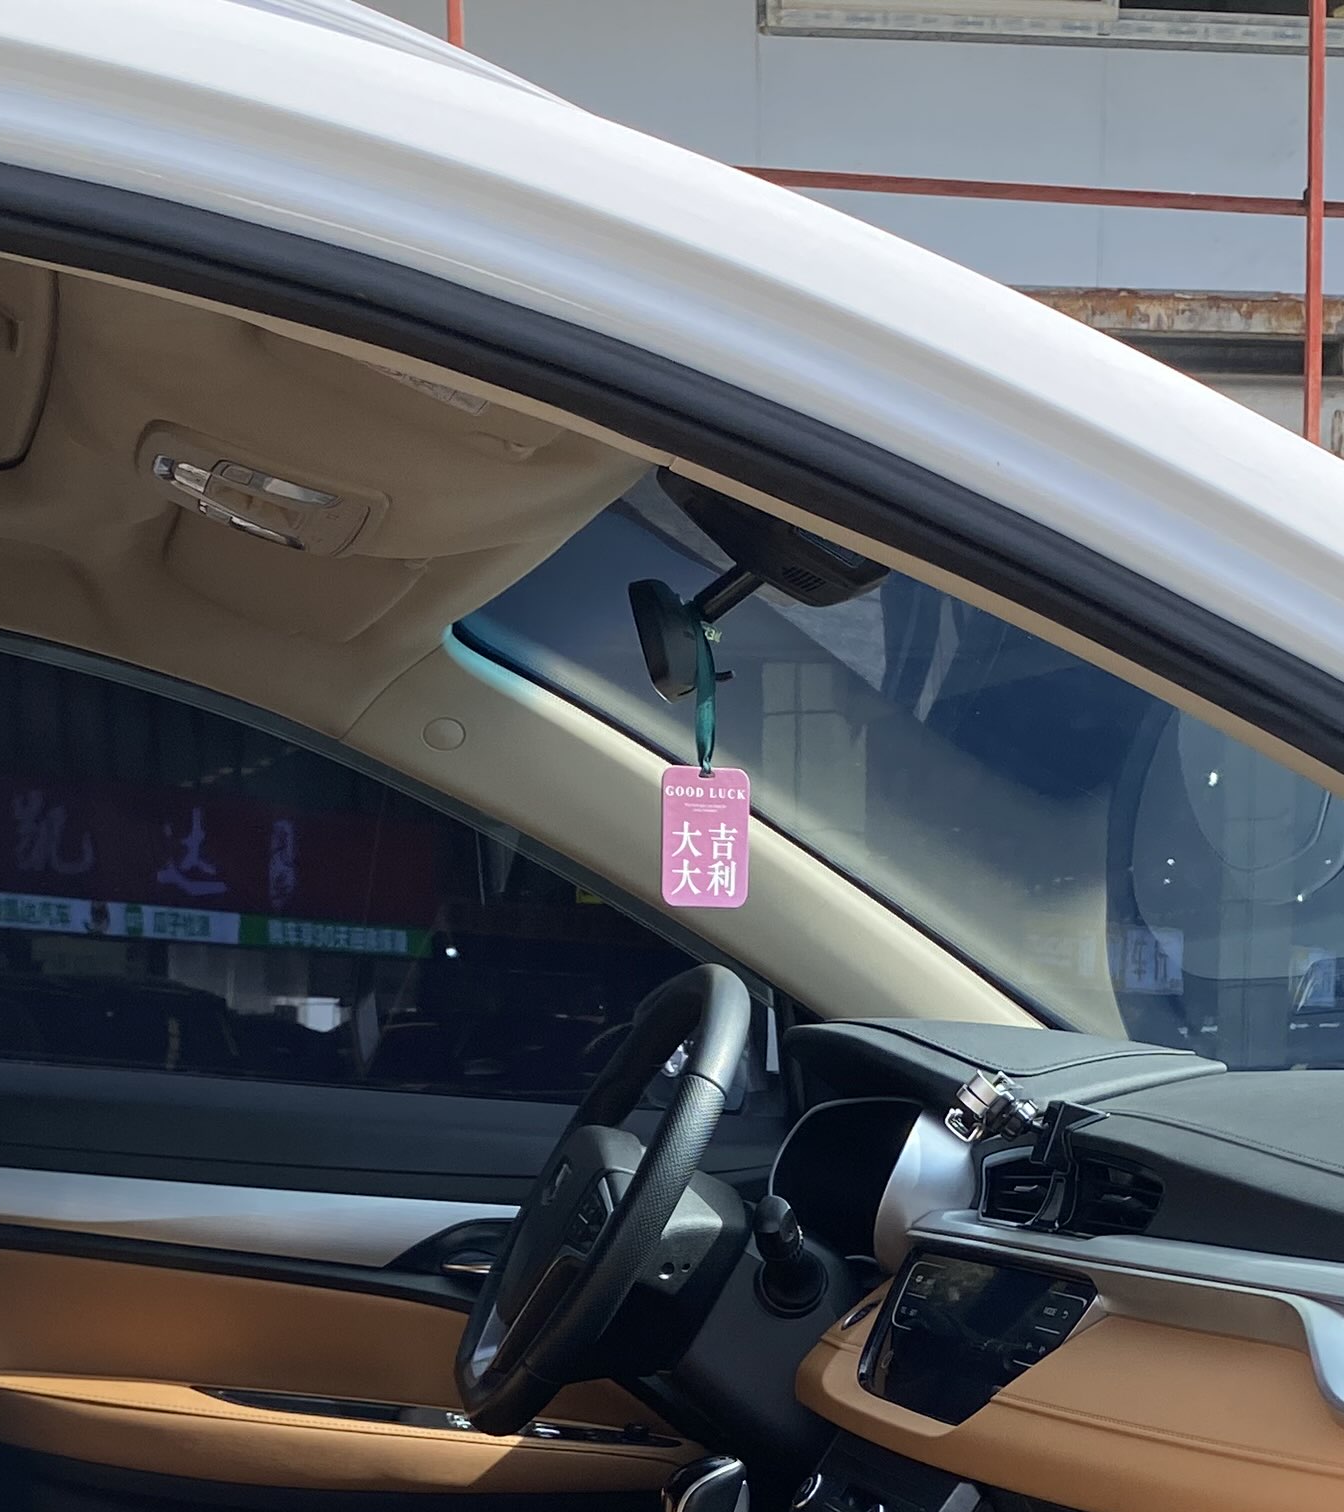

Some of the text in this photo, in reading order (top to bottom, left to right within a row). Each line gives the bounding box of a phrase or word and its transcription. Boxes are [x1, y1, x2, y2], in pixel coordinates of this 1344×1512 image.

[664, 785, 746, 800] GOOD LUCK
[671, 821, 738, 860] 大吉
[671, 858, 737, 897] 大利
